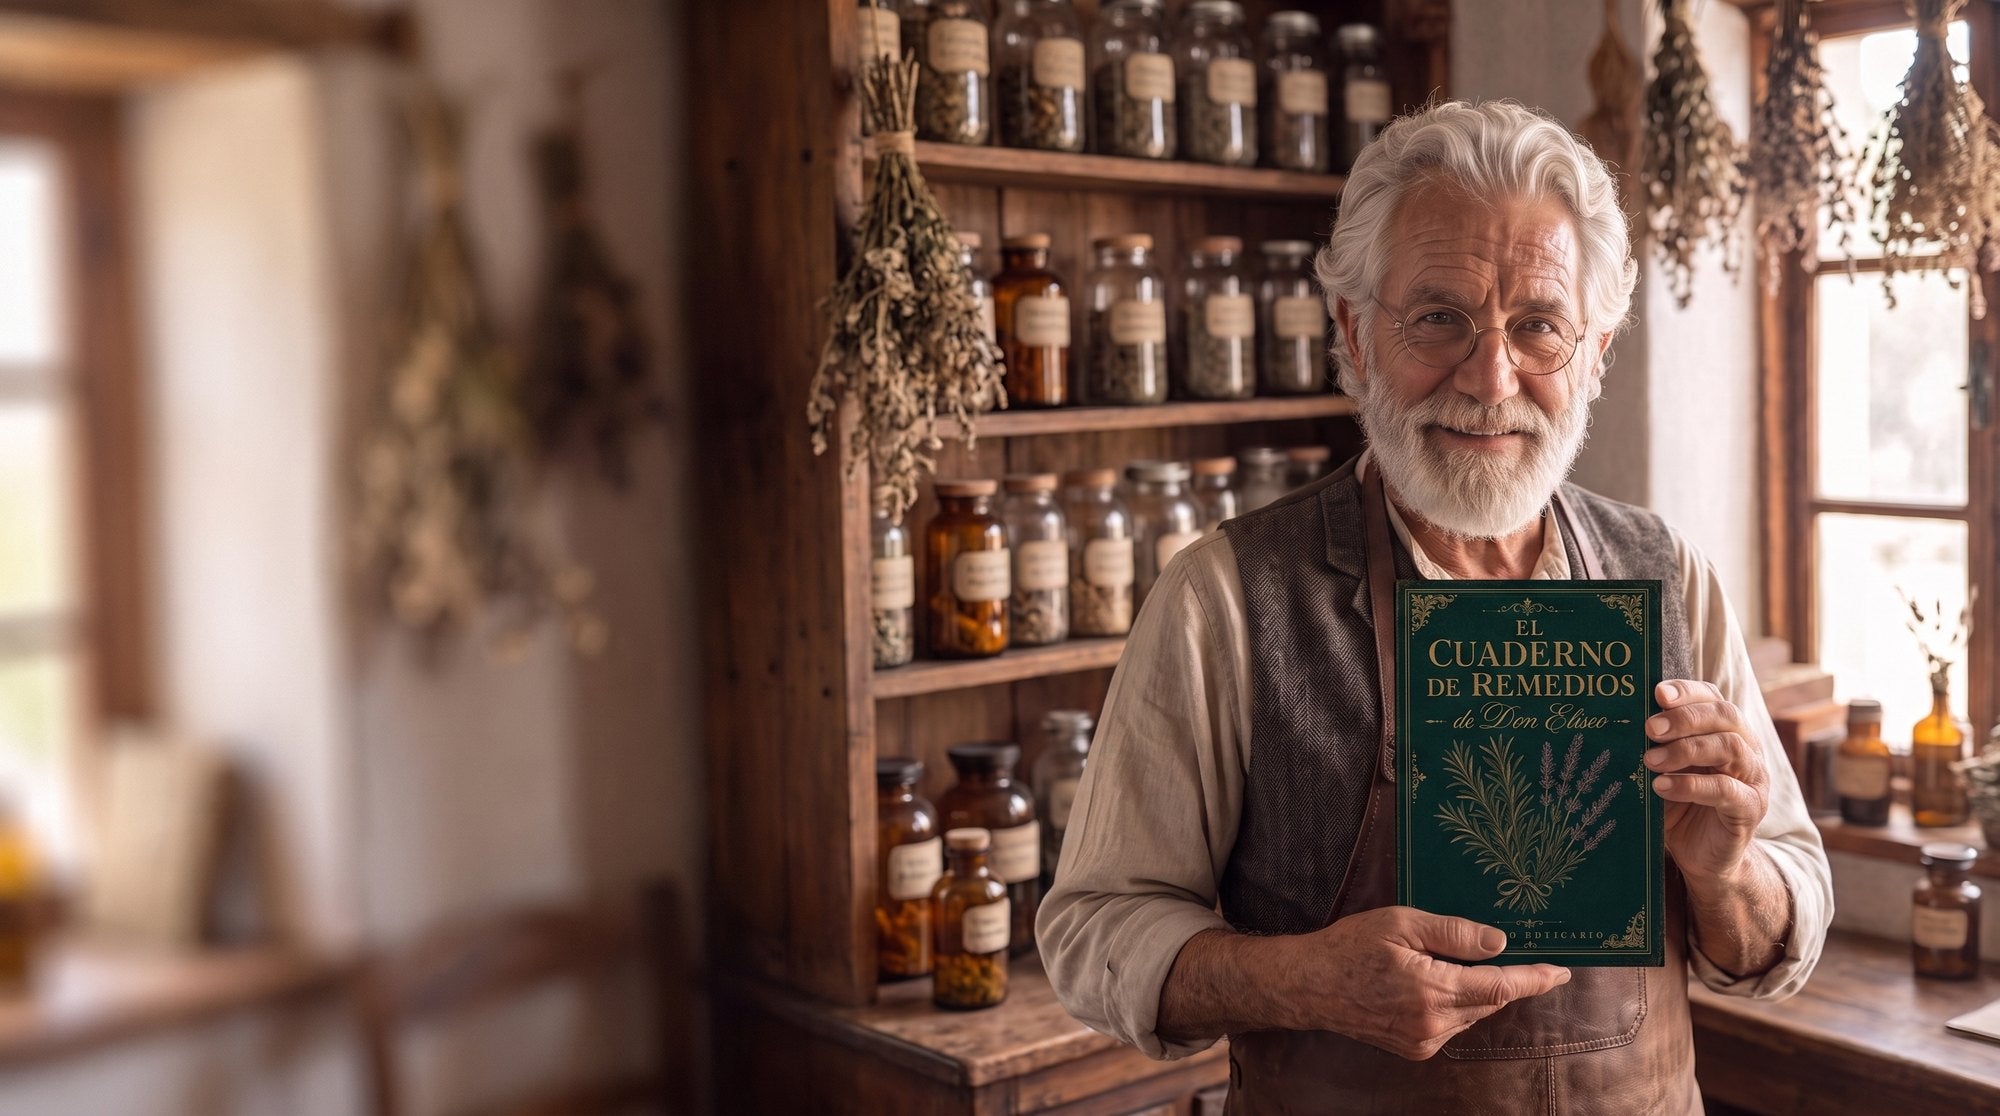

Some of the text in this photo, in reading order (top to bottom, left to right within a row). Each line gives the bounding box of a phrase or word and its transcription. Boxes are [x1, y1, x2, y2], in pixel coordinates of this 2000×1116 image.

[1516, 619, 1543, 636] EL
[1428, 638, 1632, 667] CUADERNO
[1427, 672, 1636, 697] DE REMEDIOS
[1453, 701, 1610, 734] de Don Eliseo
